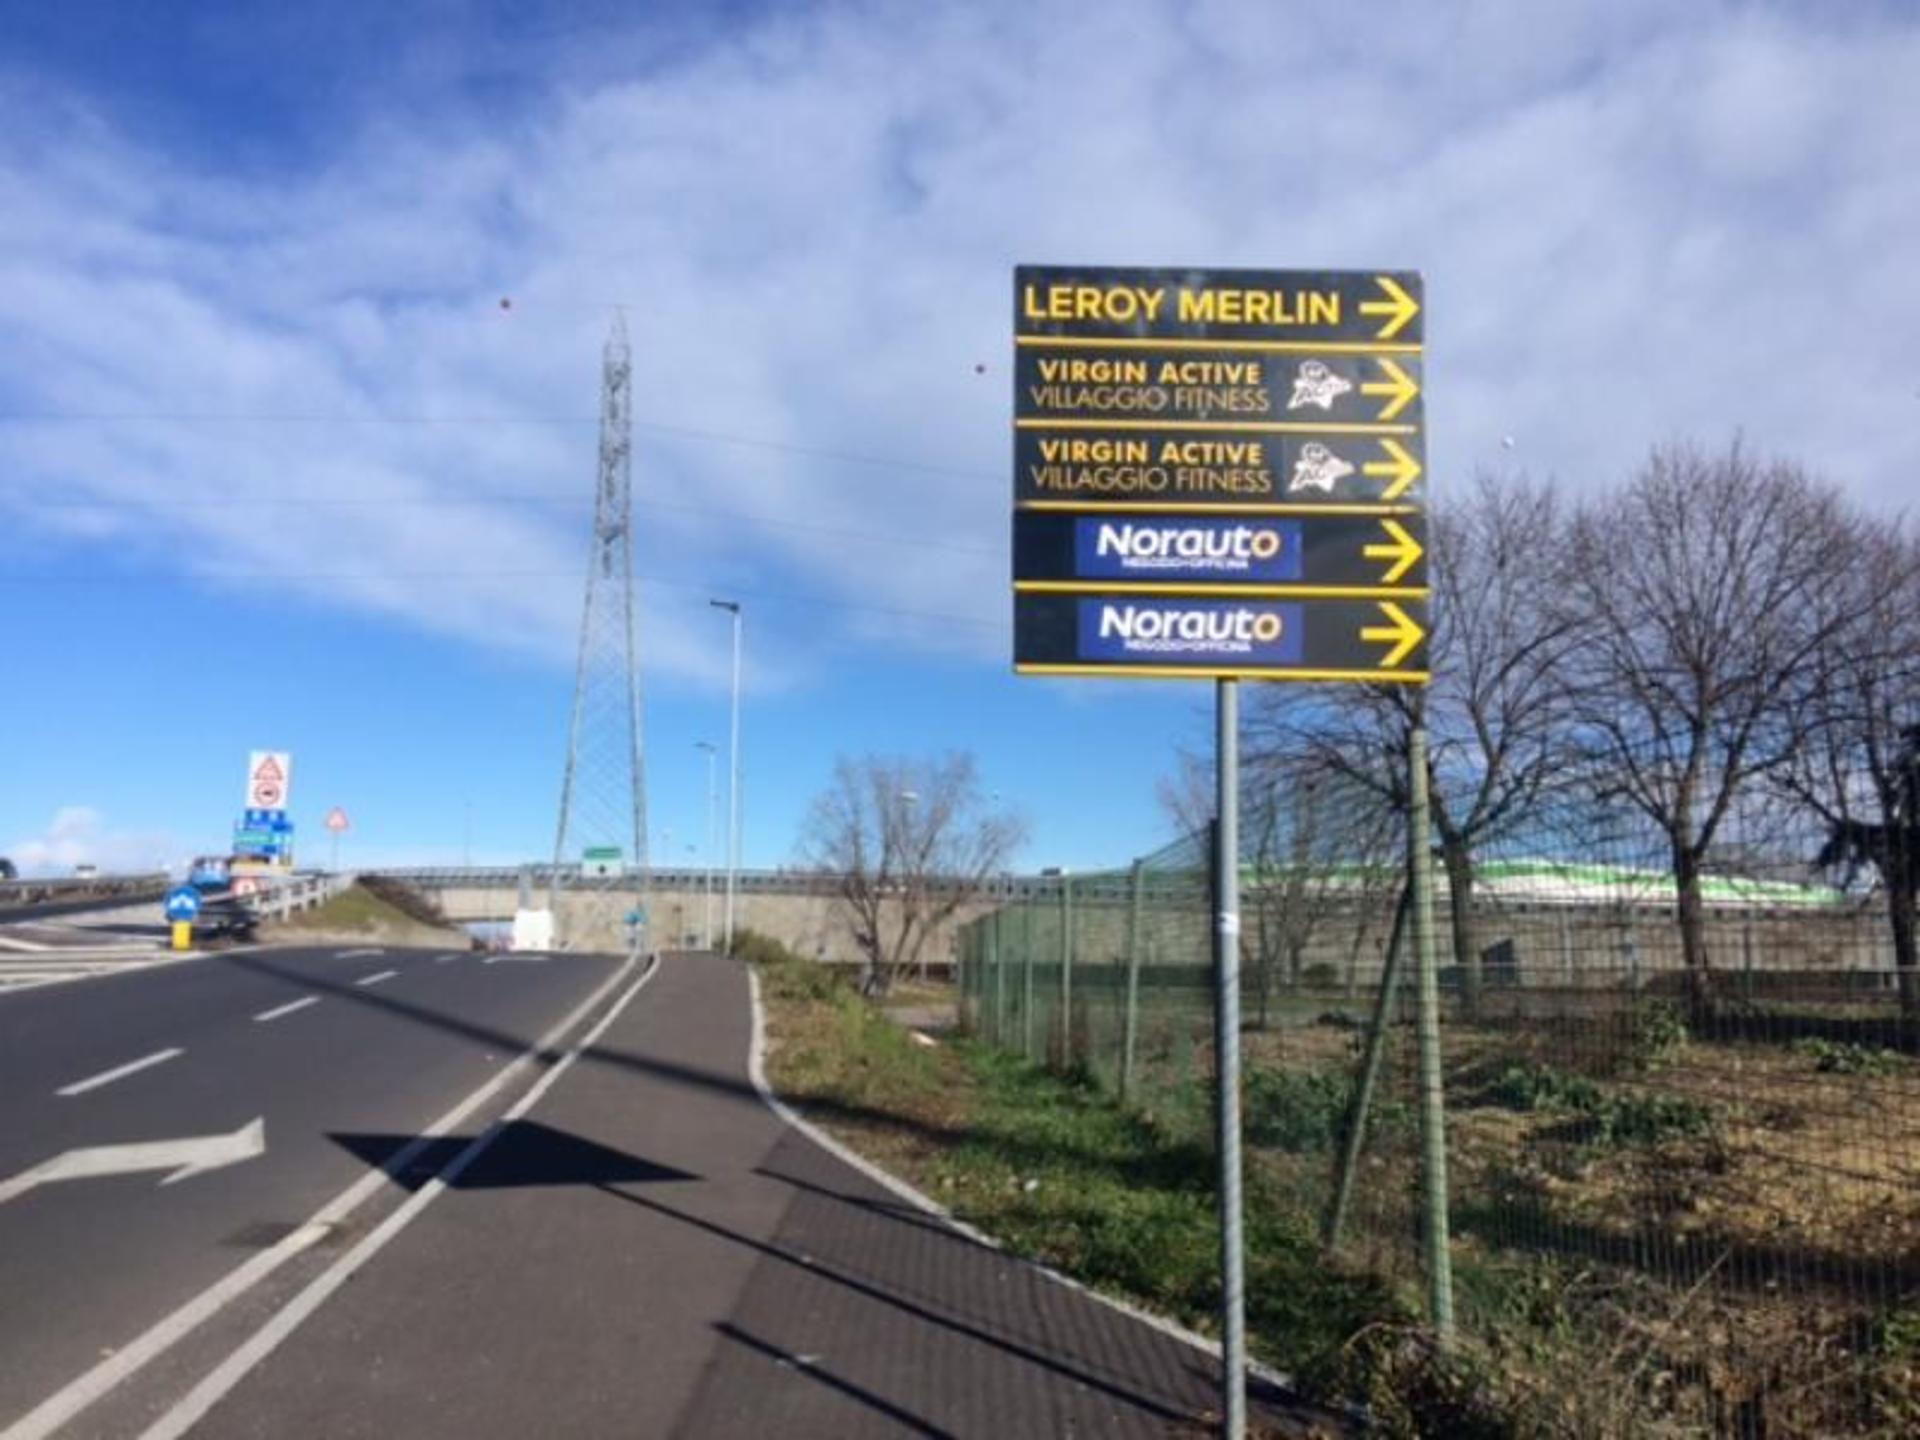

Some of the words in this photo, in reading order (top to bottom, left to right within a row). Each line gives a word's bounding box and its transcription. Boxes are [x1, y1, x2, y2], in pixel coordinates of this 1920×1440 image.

[1024, 286, 1163, 320] LEROY
[1178, 290, 1340, 324] MERLIN
[1038, 359, 1147, 383] VIRGIN
[1158, 361, 1261, 385] ACTIVE
[1029, 387, 1166, 410] VILLAGGIO
[1174, 388, 1269, 413] FITNESS
[1039, 440, 1148, 463] VIRGIN
[1160, 442, 1263, 466] ACTIVE
[1031, 467, 1168, 490] VILLAGGIO
[1176, 468, 1272, 493] FITNESS
[1096, 523, 1280, 558] Norauto
[1098, 606, 1282, 642] Norauto
